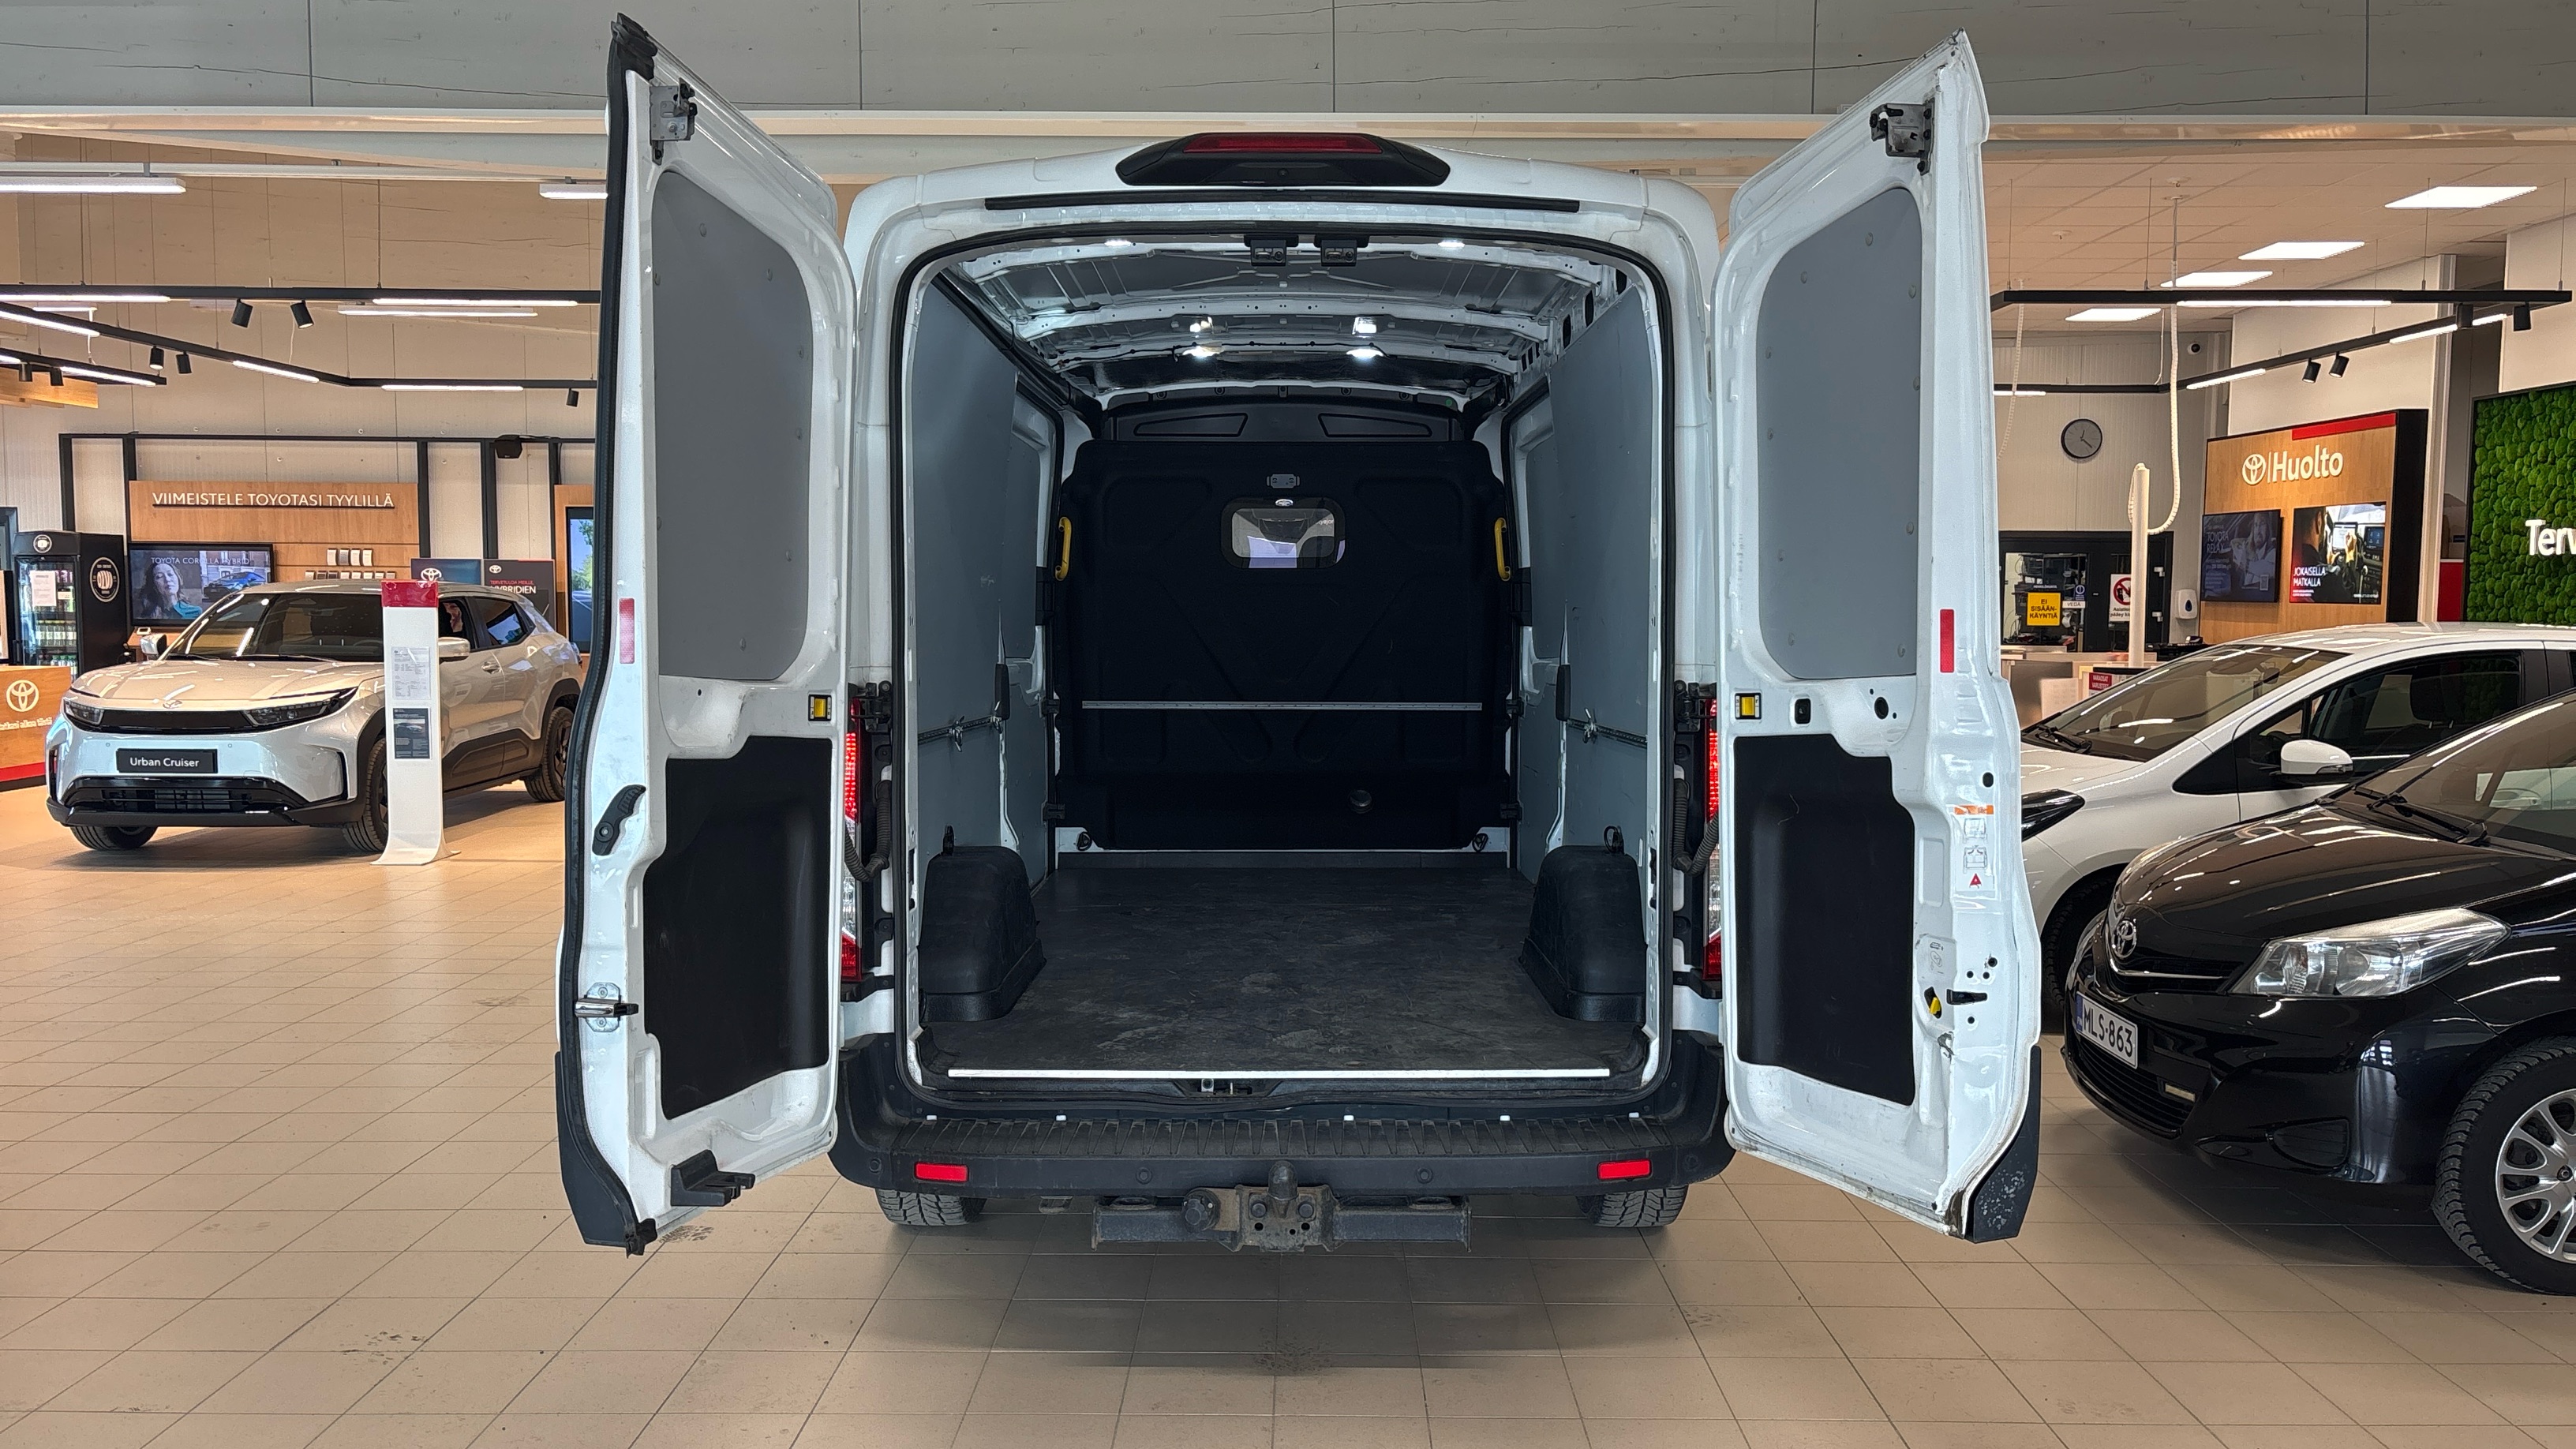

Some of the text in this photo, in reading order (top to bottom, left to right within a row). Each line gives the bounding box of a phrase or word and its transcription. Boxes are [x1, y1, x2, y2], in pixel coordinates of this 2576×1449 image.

[2272, 444, 2344, 483] Huolto
[152, 492, 395, 507] VIIMEISTELE TOYOTASI TYYLILLÄ
[2293, 567, 2326, 577] JOKAISELLA
[2293, 578, 2321, 587] MATKALLA
[129, 757, 199, 767] Urban Cruiser
[2084, 1004, 2132, 1058] MLS-863
